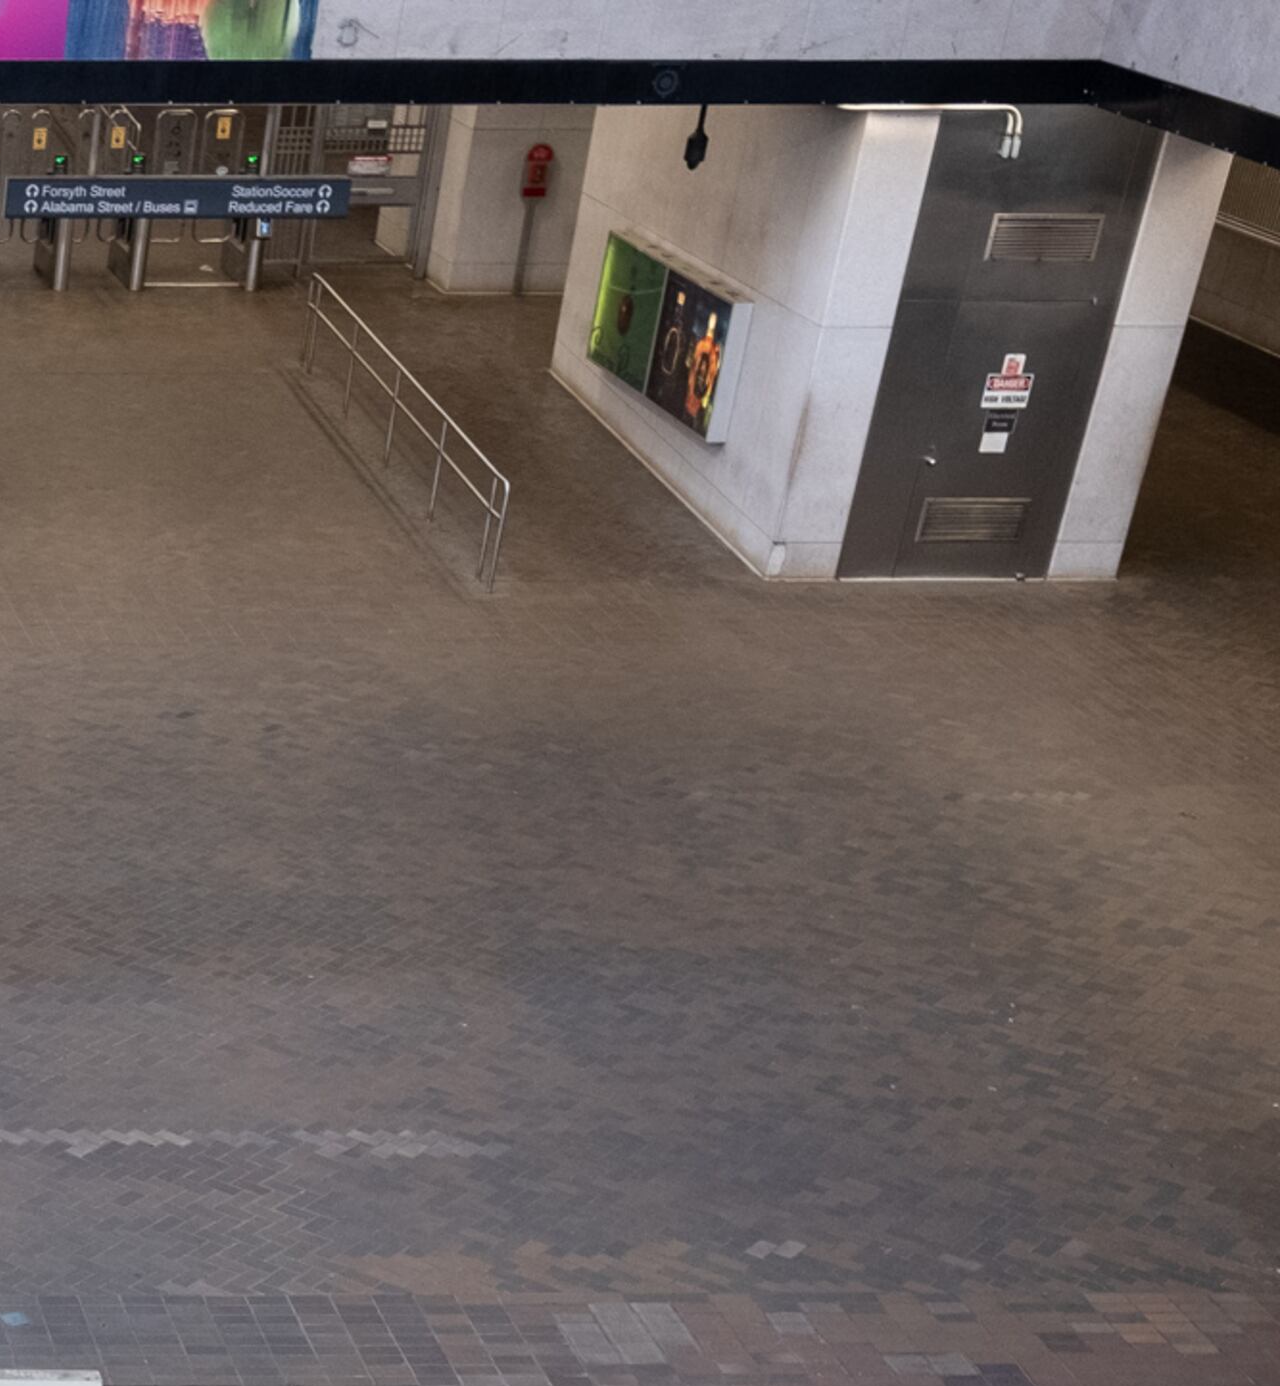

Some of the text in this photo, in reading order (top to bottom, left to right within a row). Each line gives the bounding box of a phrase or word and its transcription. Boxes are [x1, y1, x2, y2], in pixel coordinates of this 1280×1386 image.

[41, 185, 126, 199] Forsyth Street
[232, 184, 315, 198] StationSoccer
[41, 201, 94, 214] Alabama
[97, 201, 135, 214] Street
[143, 200, 181, 214] Buses
[228, 200, 314, 214] Reduced Fare
